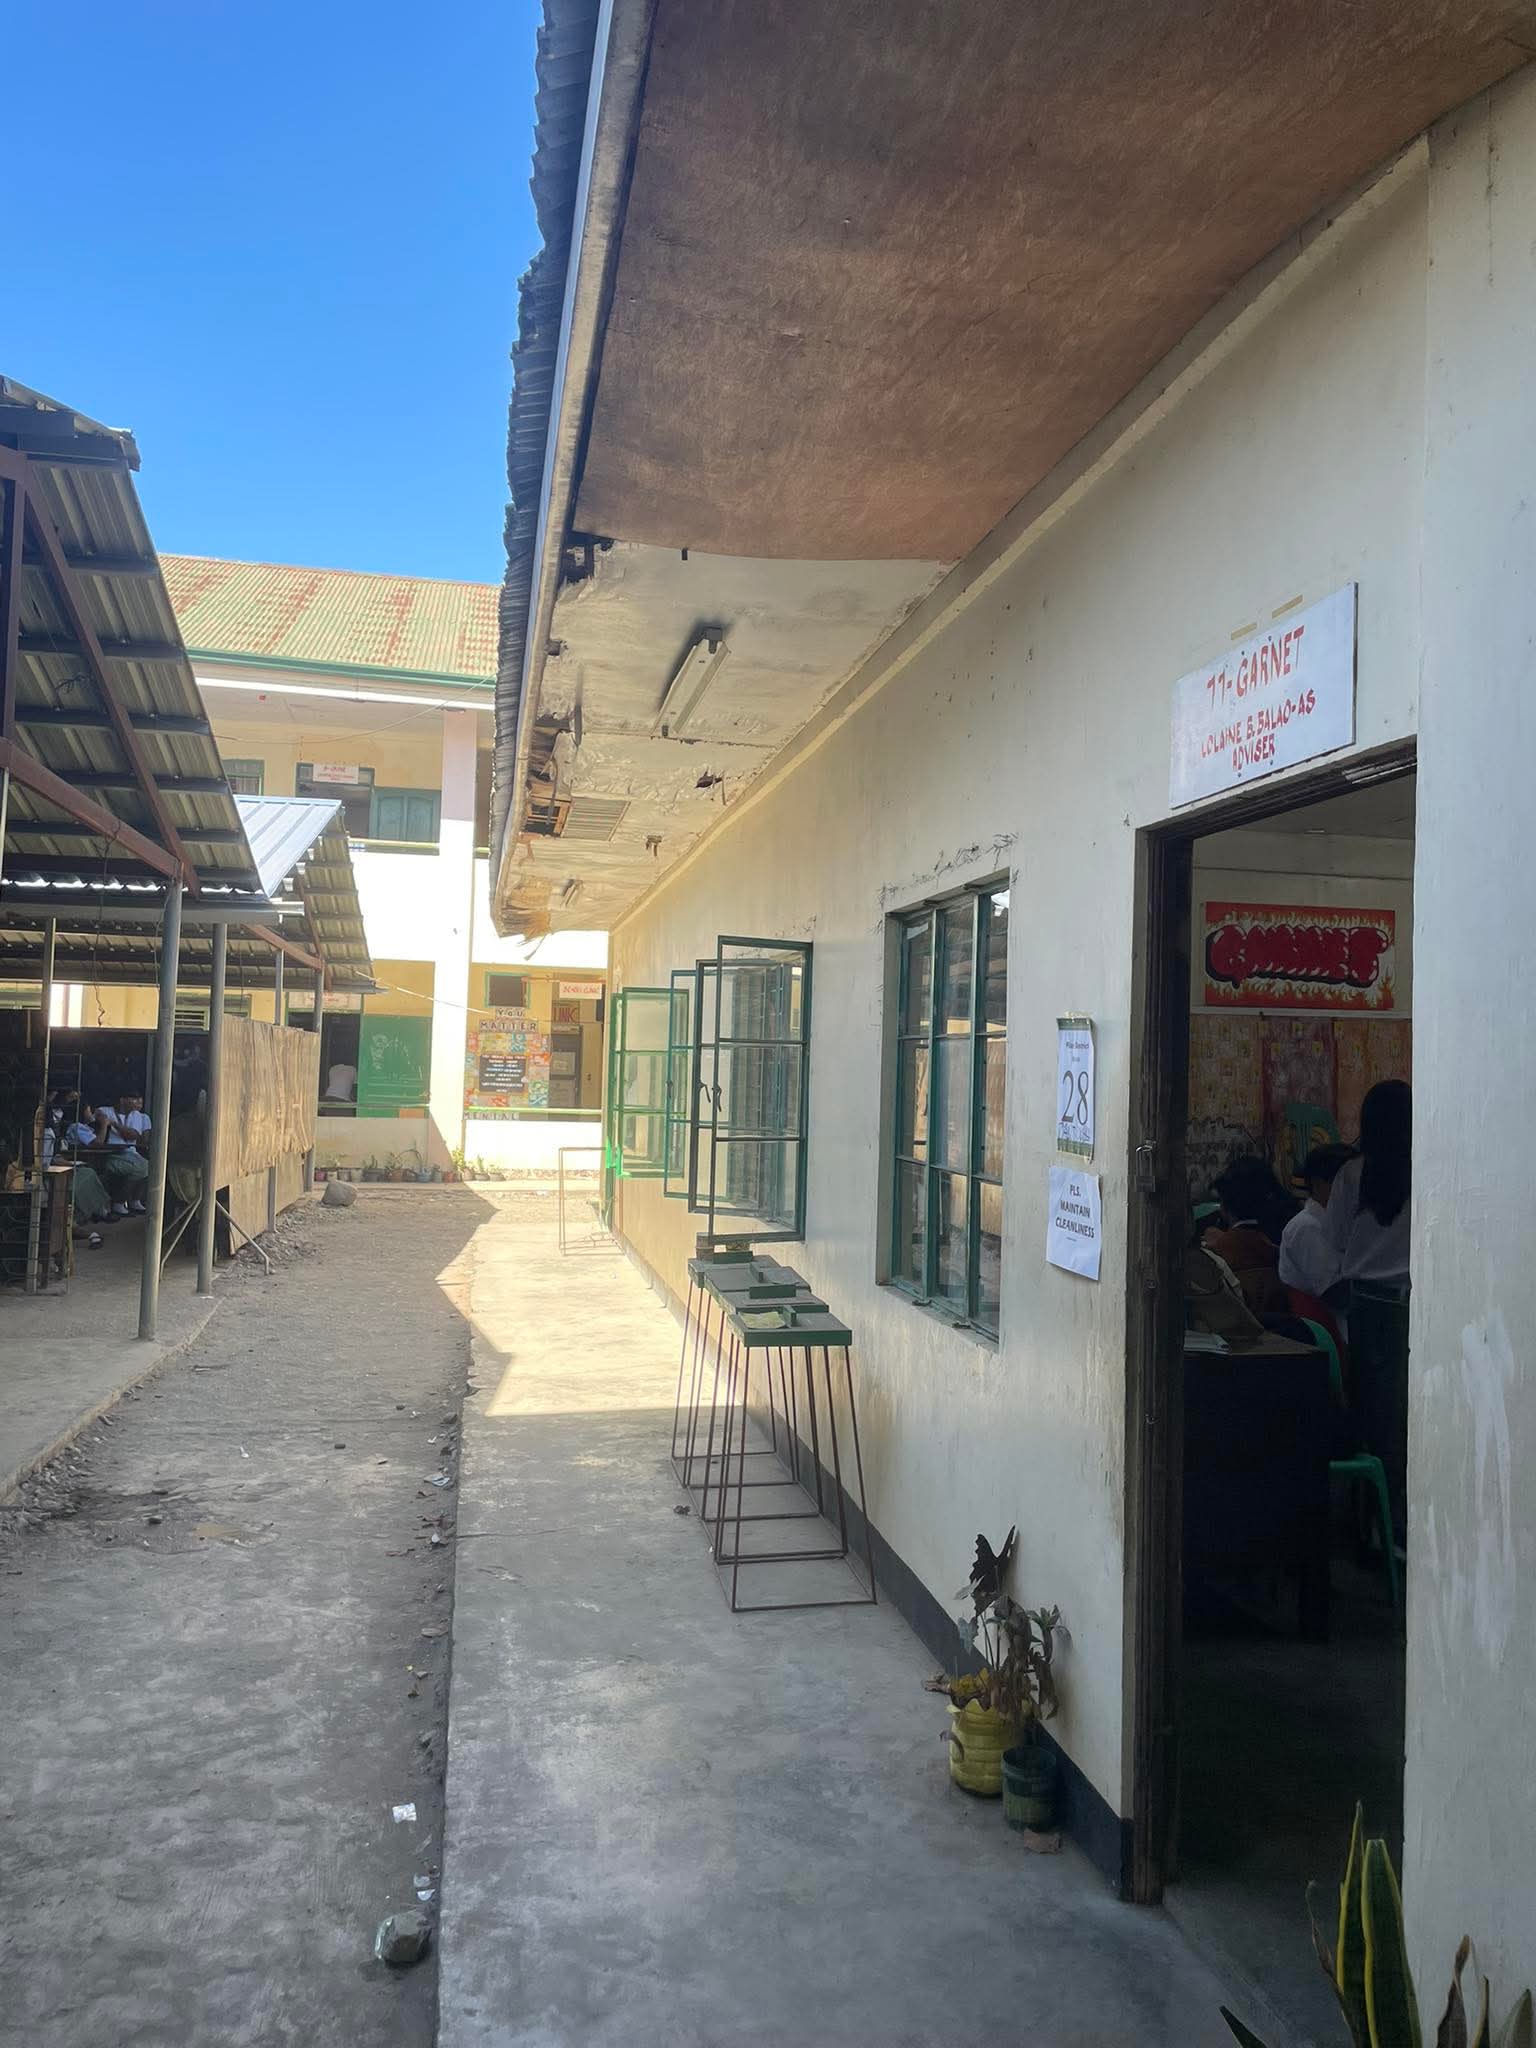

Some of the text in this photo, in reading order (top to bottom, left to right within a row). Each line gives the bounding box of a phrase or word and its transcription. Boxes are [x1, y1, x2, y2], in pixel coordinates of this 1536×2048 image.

[1232, 733, 1275, 772] ADVISER
[480, 1021, 537, 1031] MATTER
[1061, 1071, 1089, 1126] 28
[1069, 1183, 1082, 1198] PLS.
[1060, 1200, 1091, 1219] MAINTAIN
[1055, 1216, 1095, 1239] CLEANLINESS
